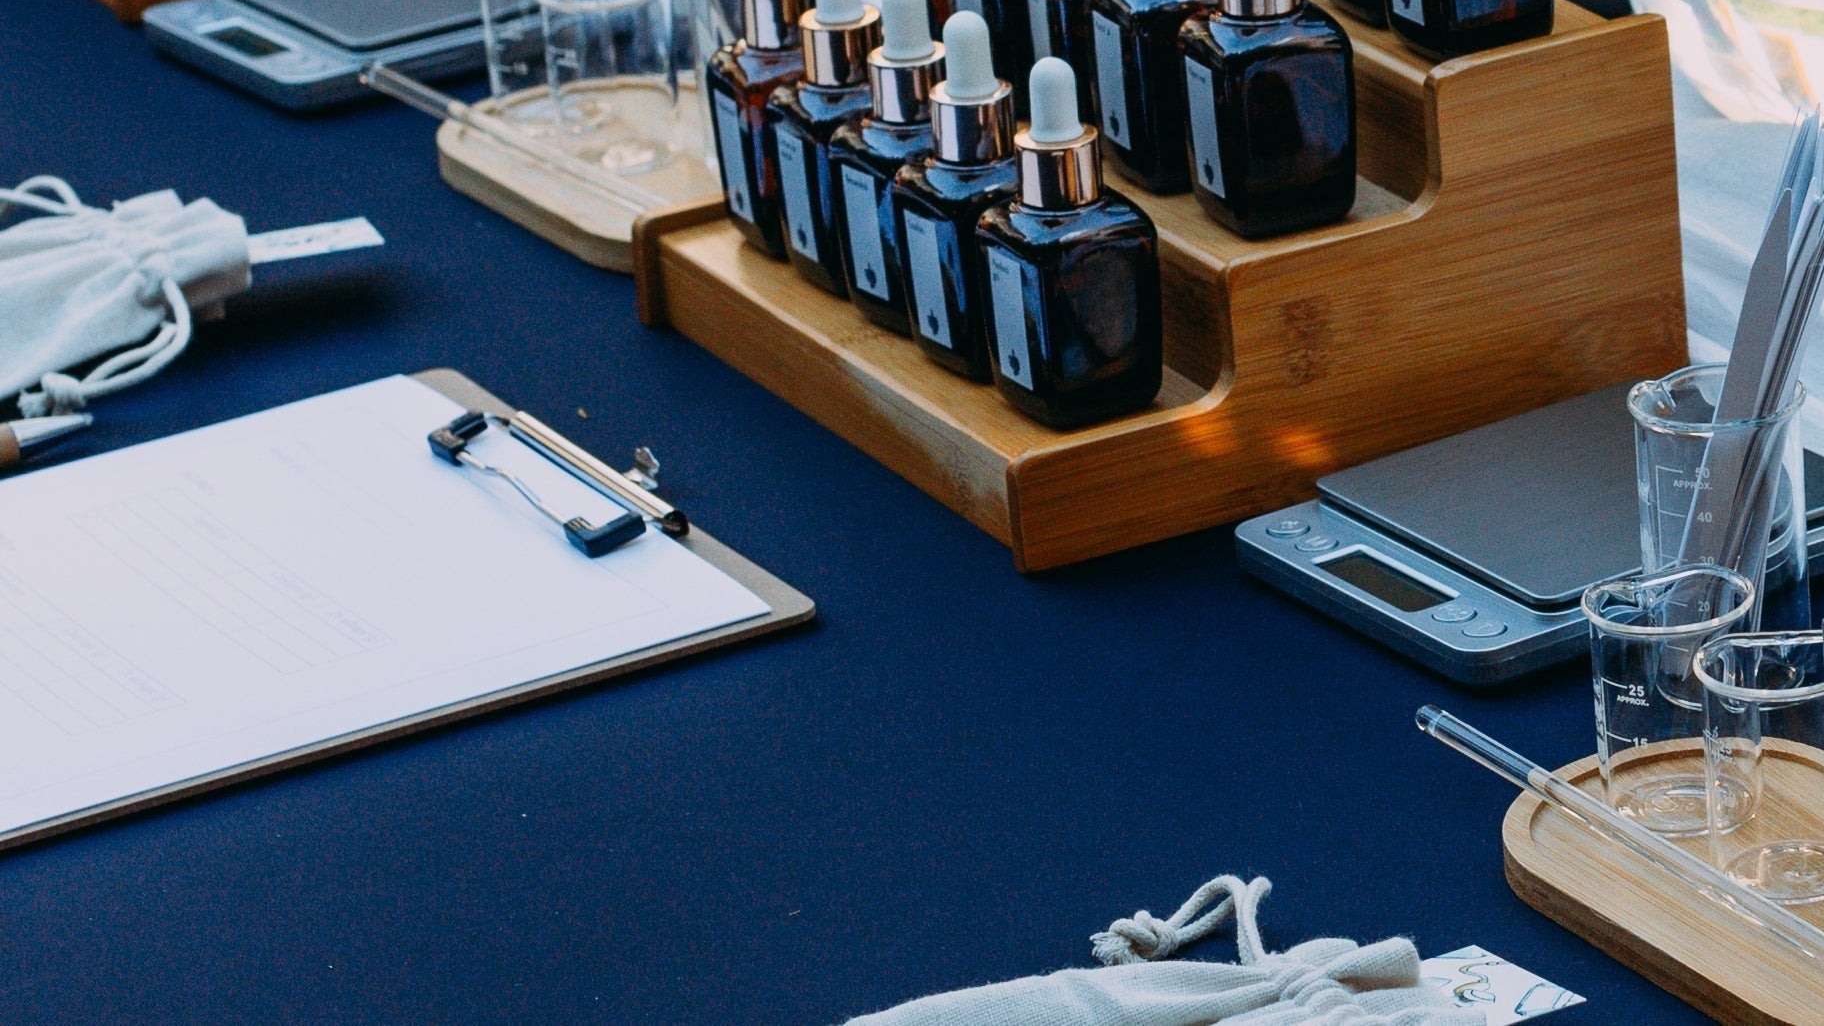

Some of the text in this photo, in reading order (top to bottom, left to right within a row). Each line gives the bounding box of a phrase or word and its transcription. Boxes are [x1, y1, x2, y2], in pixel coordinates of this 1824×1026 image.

[1696, 512, 1713, 523] 40
[1699, 555, 1715, 566] 30
[1697, 601, 1711, 612] 20
[1628, 684, 1645, 698] 25
[1616, 694, 1650, 707] APPROX.
[1632, 737, 1649, 750] 15
